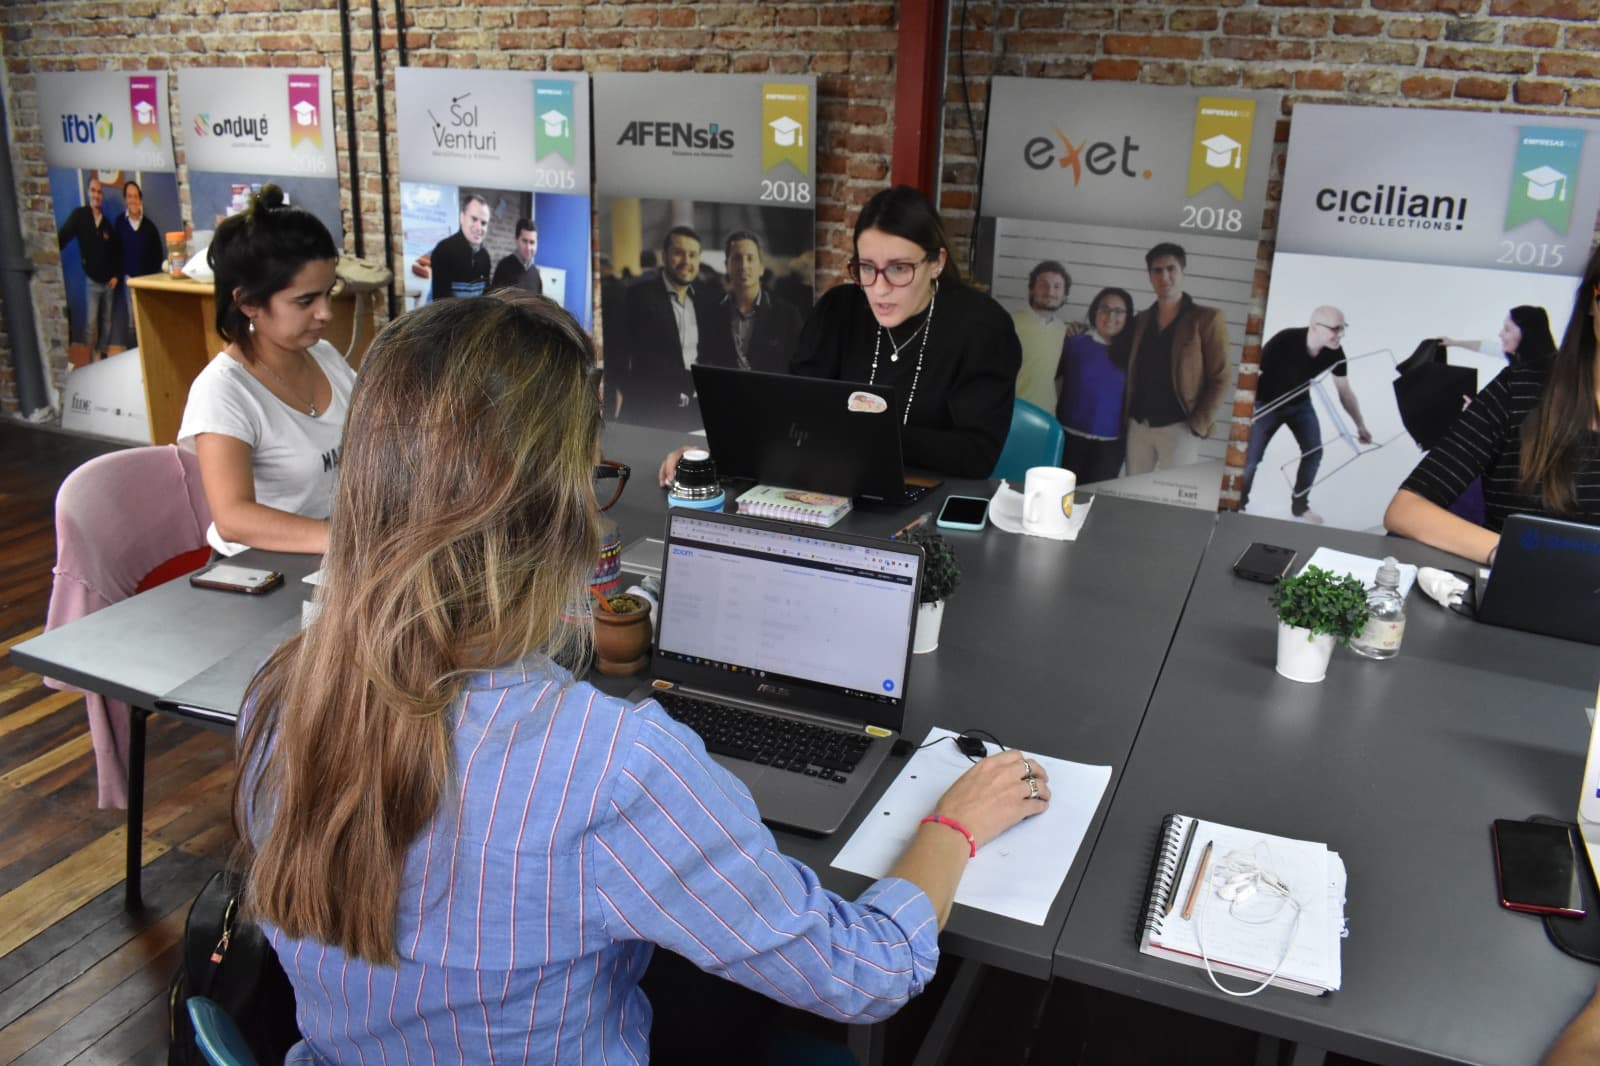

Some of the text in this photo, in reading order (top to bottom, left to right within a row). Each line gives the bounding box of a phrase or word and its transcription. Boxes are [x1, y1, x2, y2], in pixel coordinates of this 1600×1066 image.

[450, 103, 478, 128] Sol
[432, 125, 497, 151] Venturi
[535, 168, 576, 189] 2015
[759, 180, 811, 203] 2018
[1179, 205, 1243, 232] 2018
[1349, 215, 1452, 231] COLLECTIONS
[1496, 240, 1566, 268] 2015
[672, 548, 694, 558] zoom
